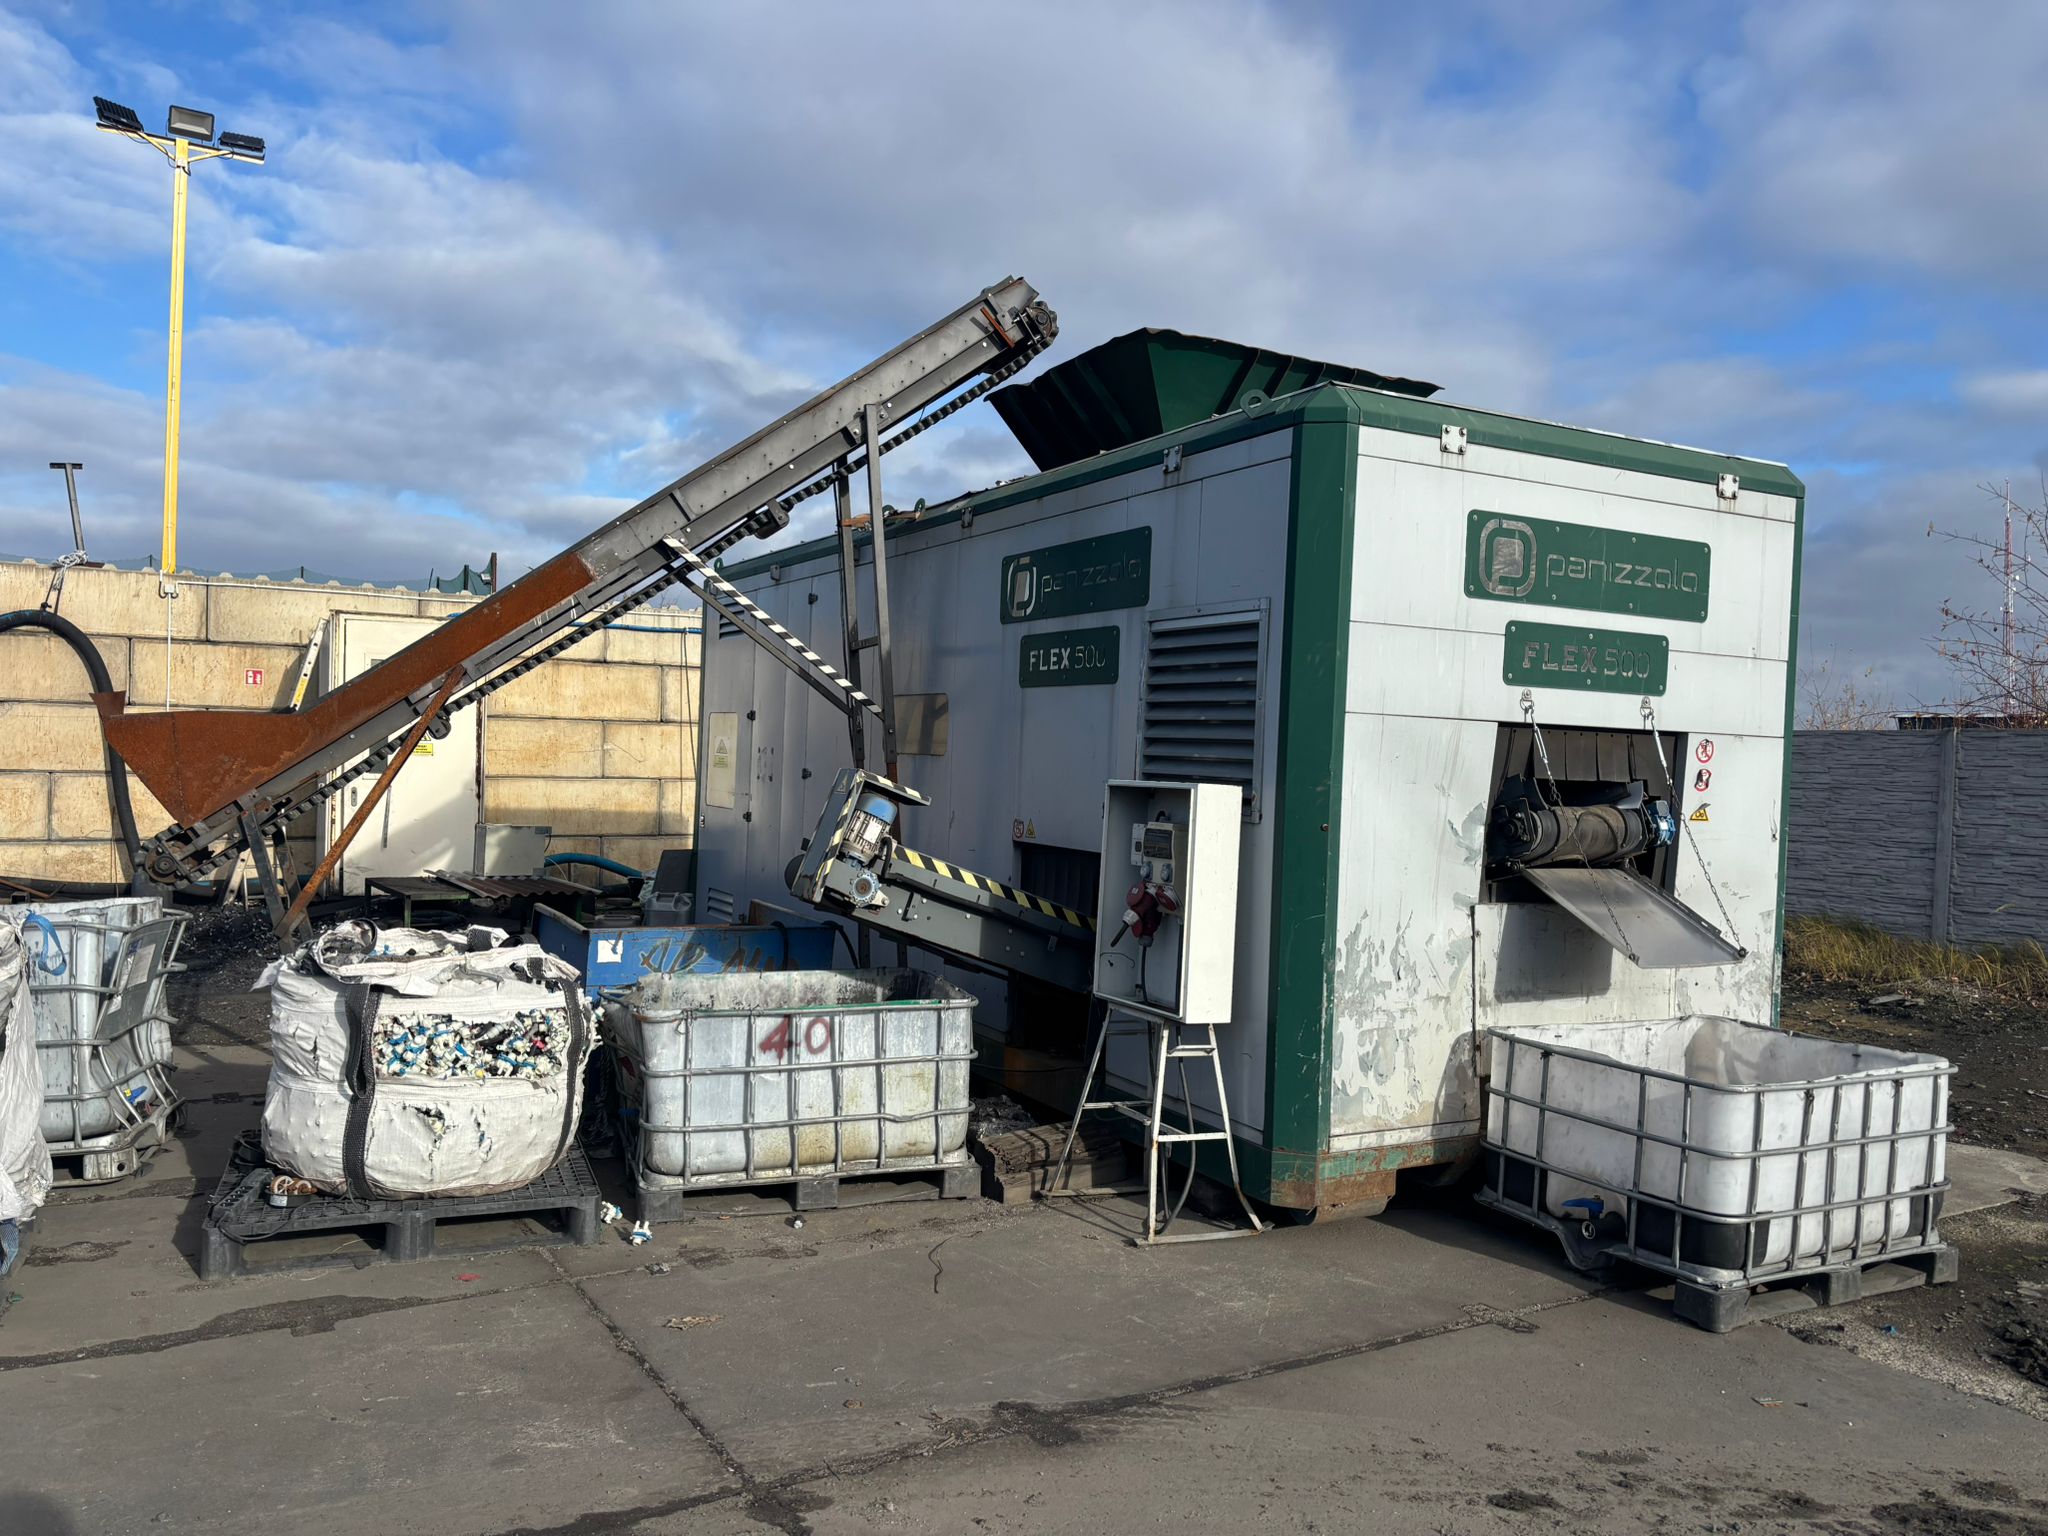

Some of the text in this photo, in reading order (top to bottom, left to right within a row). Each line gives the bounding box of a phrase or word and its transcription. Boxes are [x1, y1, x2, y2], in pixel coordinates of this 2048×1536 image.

[1041, 553, 1142, 602] panzzolo
[1546, 553, 1698, 592] panizzolo
[1030, 645, 1105, 671] FLEX 500
[1522, 641, 1650, 678] FLEX 500
